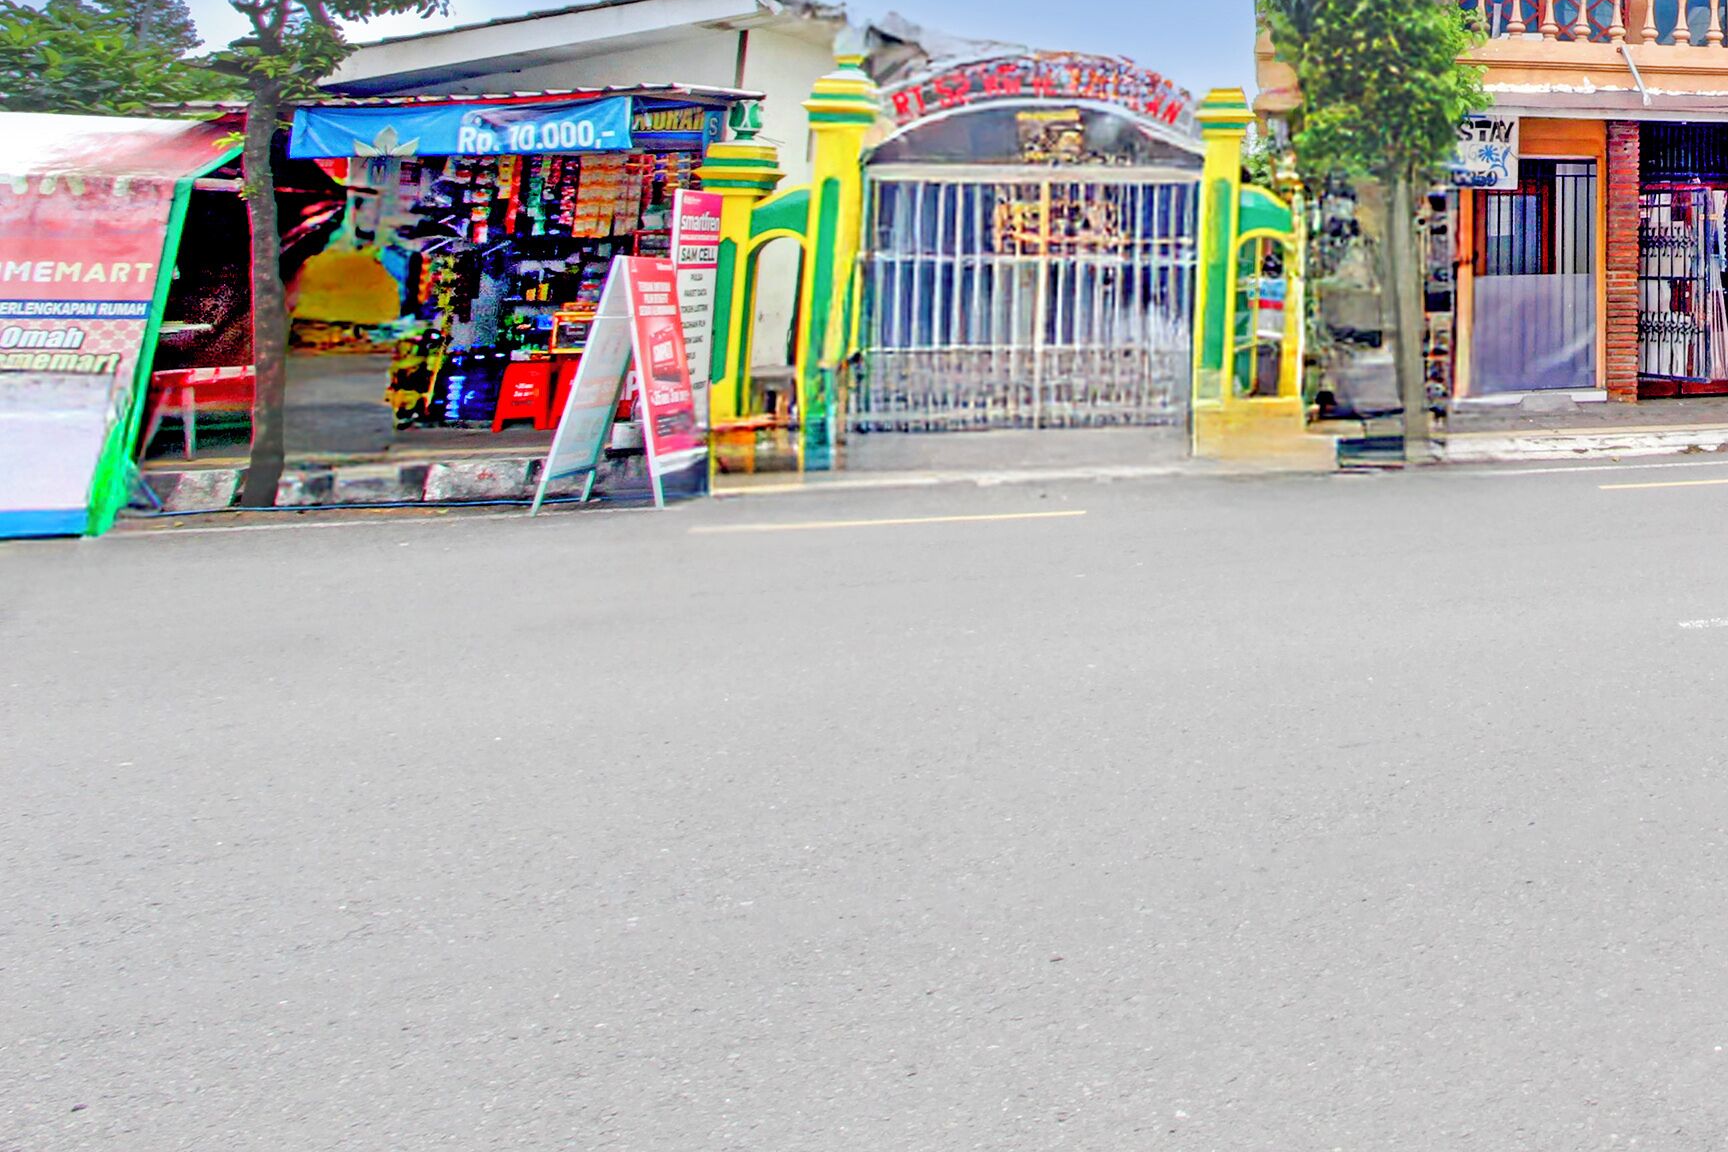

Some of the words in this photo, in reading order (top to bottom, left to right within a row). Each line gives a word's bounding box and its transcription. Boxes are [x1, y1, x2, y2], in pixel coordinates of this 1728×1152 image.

[457, 126, 499, 155] Rp.
[681, 248, 698, 262] SAM
[699, 247, 715, 262] CELL
[0, 260, 154, 282] MEMART
[98, 302, 147, 315] RUMAH
[1, 325, 86, 349] Omah
